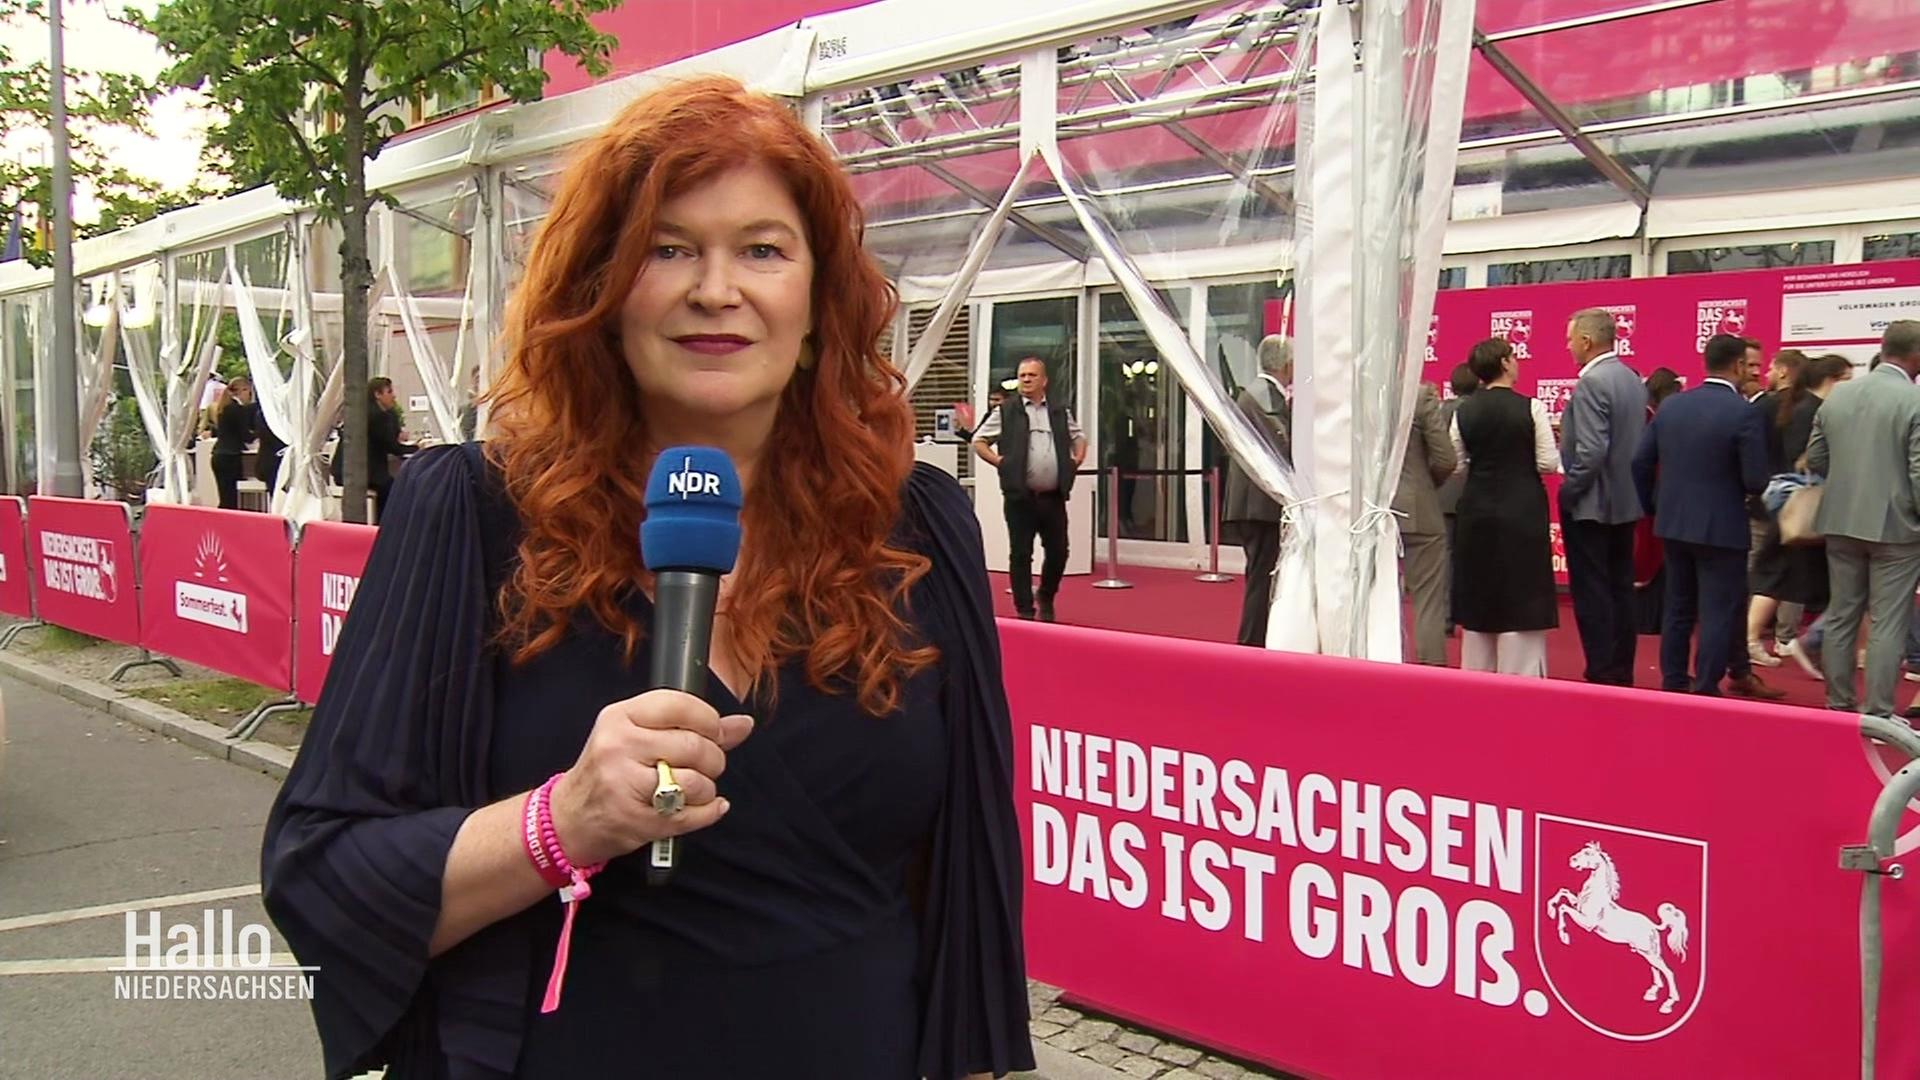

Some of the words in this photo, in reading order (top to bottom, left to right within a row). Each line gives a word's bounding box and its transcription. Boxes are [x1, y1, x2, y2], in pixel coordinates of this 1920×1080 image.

[1838, 302, 1896, 310] VOLKSWAGEN
[1697, 307, 1723, 322] DAS
[1491, 318, 1513, 331] DAS
[1696, 321, 1718, 336] IST
[1537, 386, 1560, 399] DAS
[668, 469, 721, 498] NDR
[1031, 724, 1523, 894] NIEDERSACHSEN
[1031, 802, 1149, 909] DAS
[1161, 832, 1276, 942] IST
